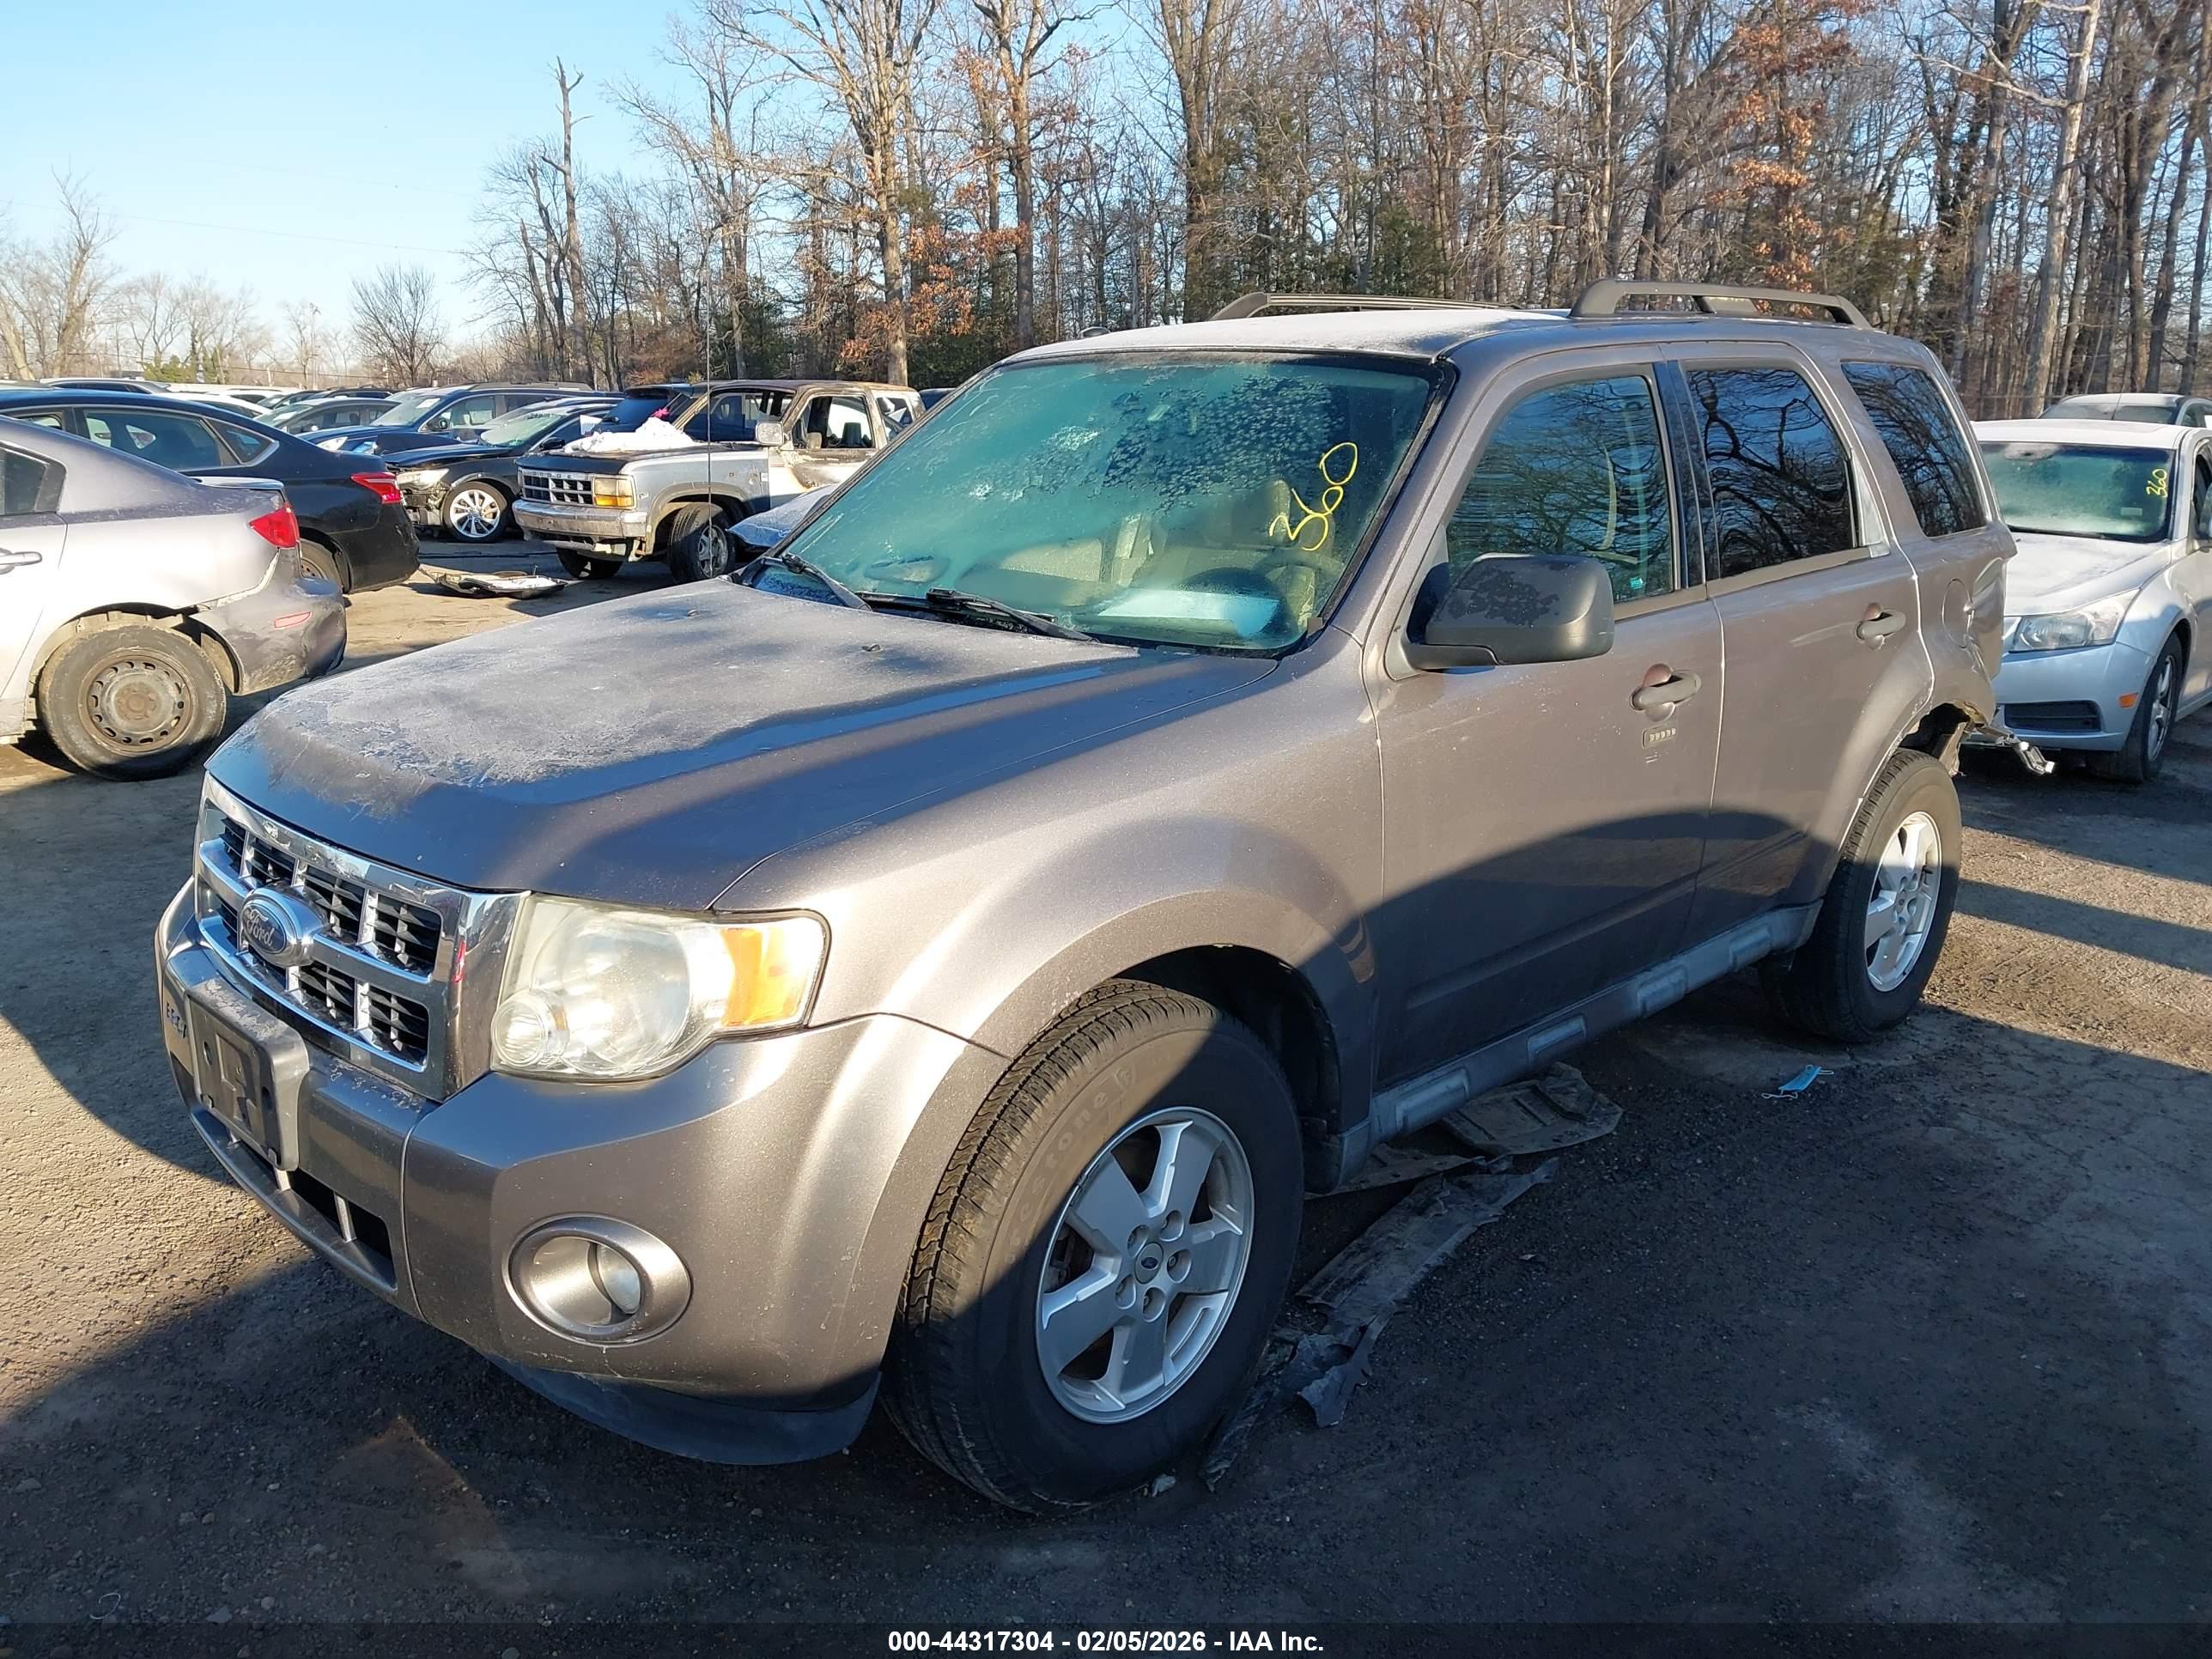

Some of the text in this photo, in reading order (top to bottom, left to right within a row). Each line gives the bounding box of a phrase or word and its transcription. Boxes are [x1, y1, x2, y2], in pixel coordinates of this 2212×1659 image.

[1268, 441, 1358, 551] 360
[2146, 468, 2168, 498] 360
[243, 906, 275, 946] Ford
